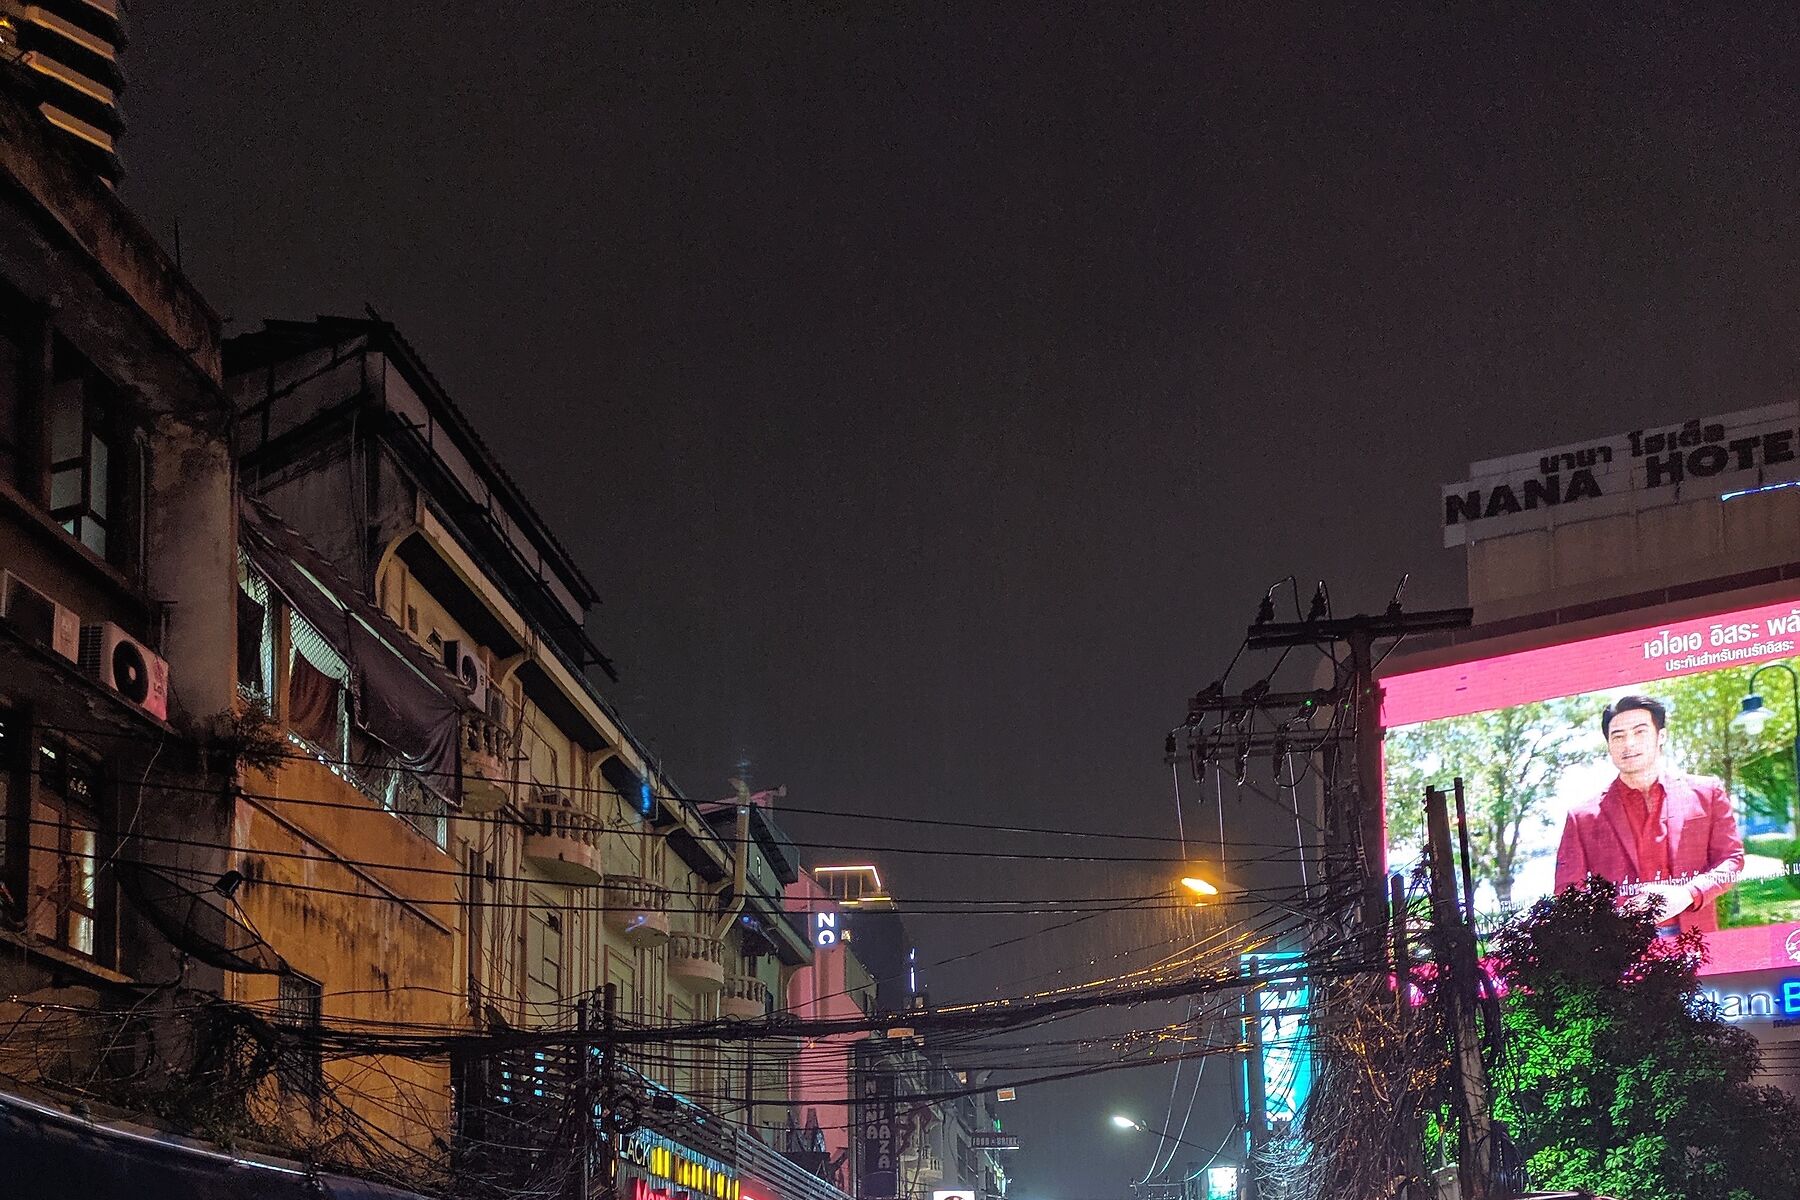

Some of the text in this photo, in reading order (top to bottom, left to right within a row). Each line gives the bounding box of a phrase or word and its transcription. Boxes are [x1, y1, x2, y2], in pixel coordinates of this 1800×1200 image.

[1445, 426, 1800, 526] NANA HOTE
[1643, 630, 1703, 660] เอไอเอ
[1710, 624, 1760, 648] อิสระ
